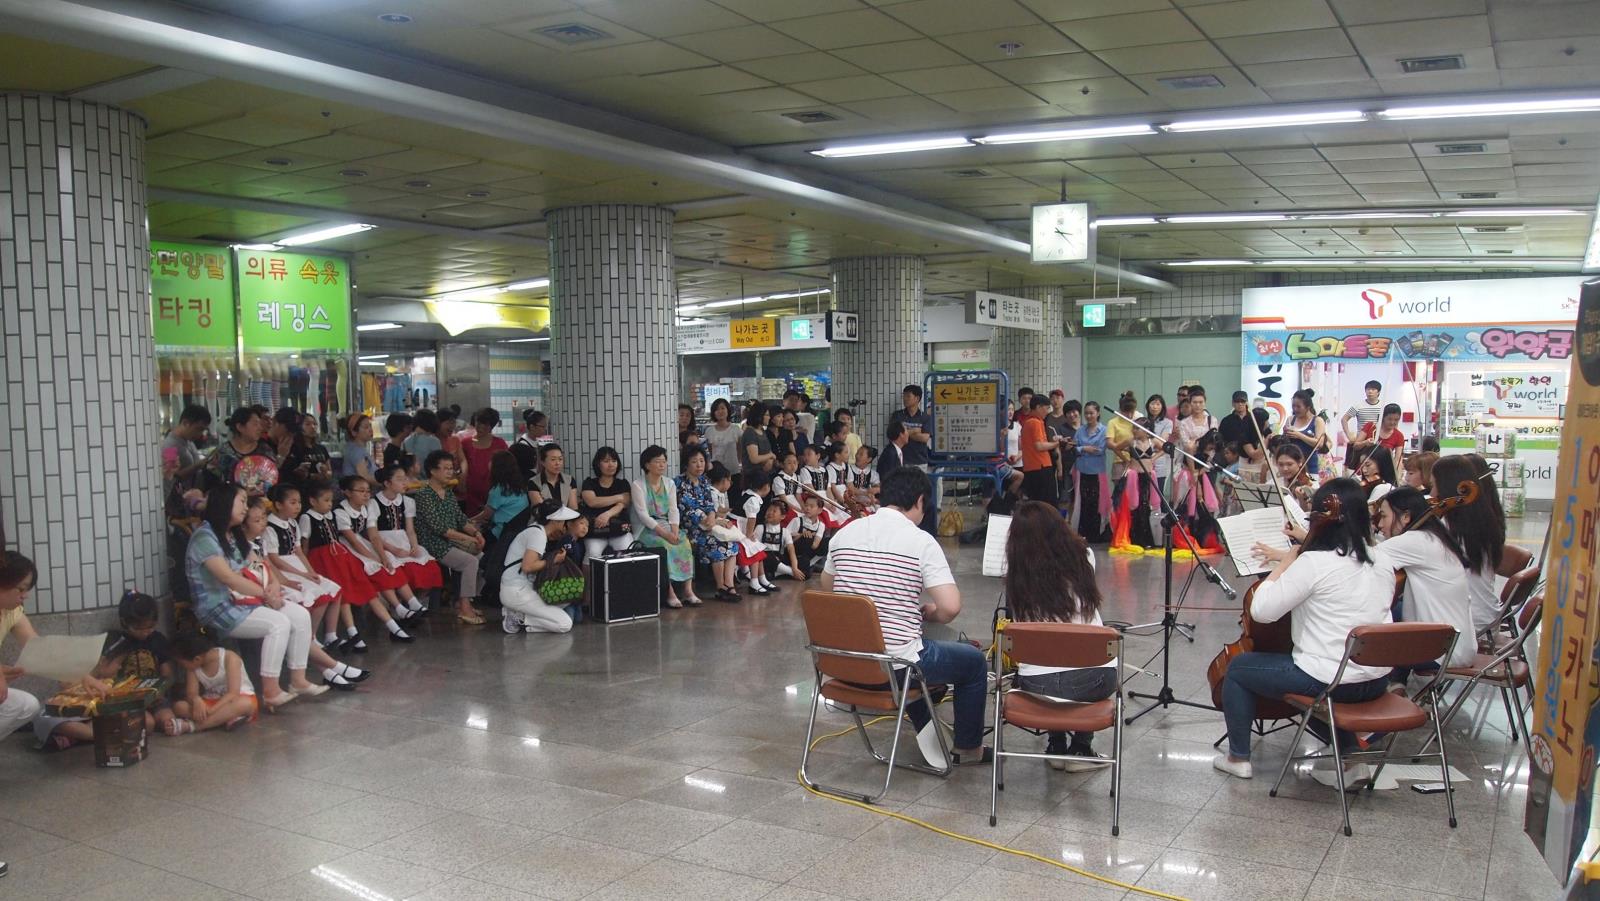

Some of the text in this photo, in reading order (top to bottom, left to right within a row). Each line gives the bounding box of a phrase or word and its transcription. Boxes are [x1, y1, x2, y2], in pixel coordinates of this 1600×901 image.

[245, 256, 340, 285] 의류 속옷
[158, 296, 213, 329] 타킹
[1398, 295, 1451, 315] world
[257, 301, 333, 334] 레깅스
[735, 324, 759, 335] 나가는
[762, 323, 769, 334] 곳
[1284, 332, 1394, 361] 스마트폰
[1480, 327, 1575, 361] 위약금
[956, 385, 990, 396] 나가는 곳
[1514, 387, 1557, 401] world
[1525, 465, 1552, 480] orld
